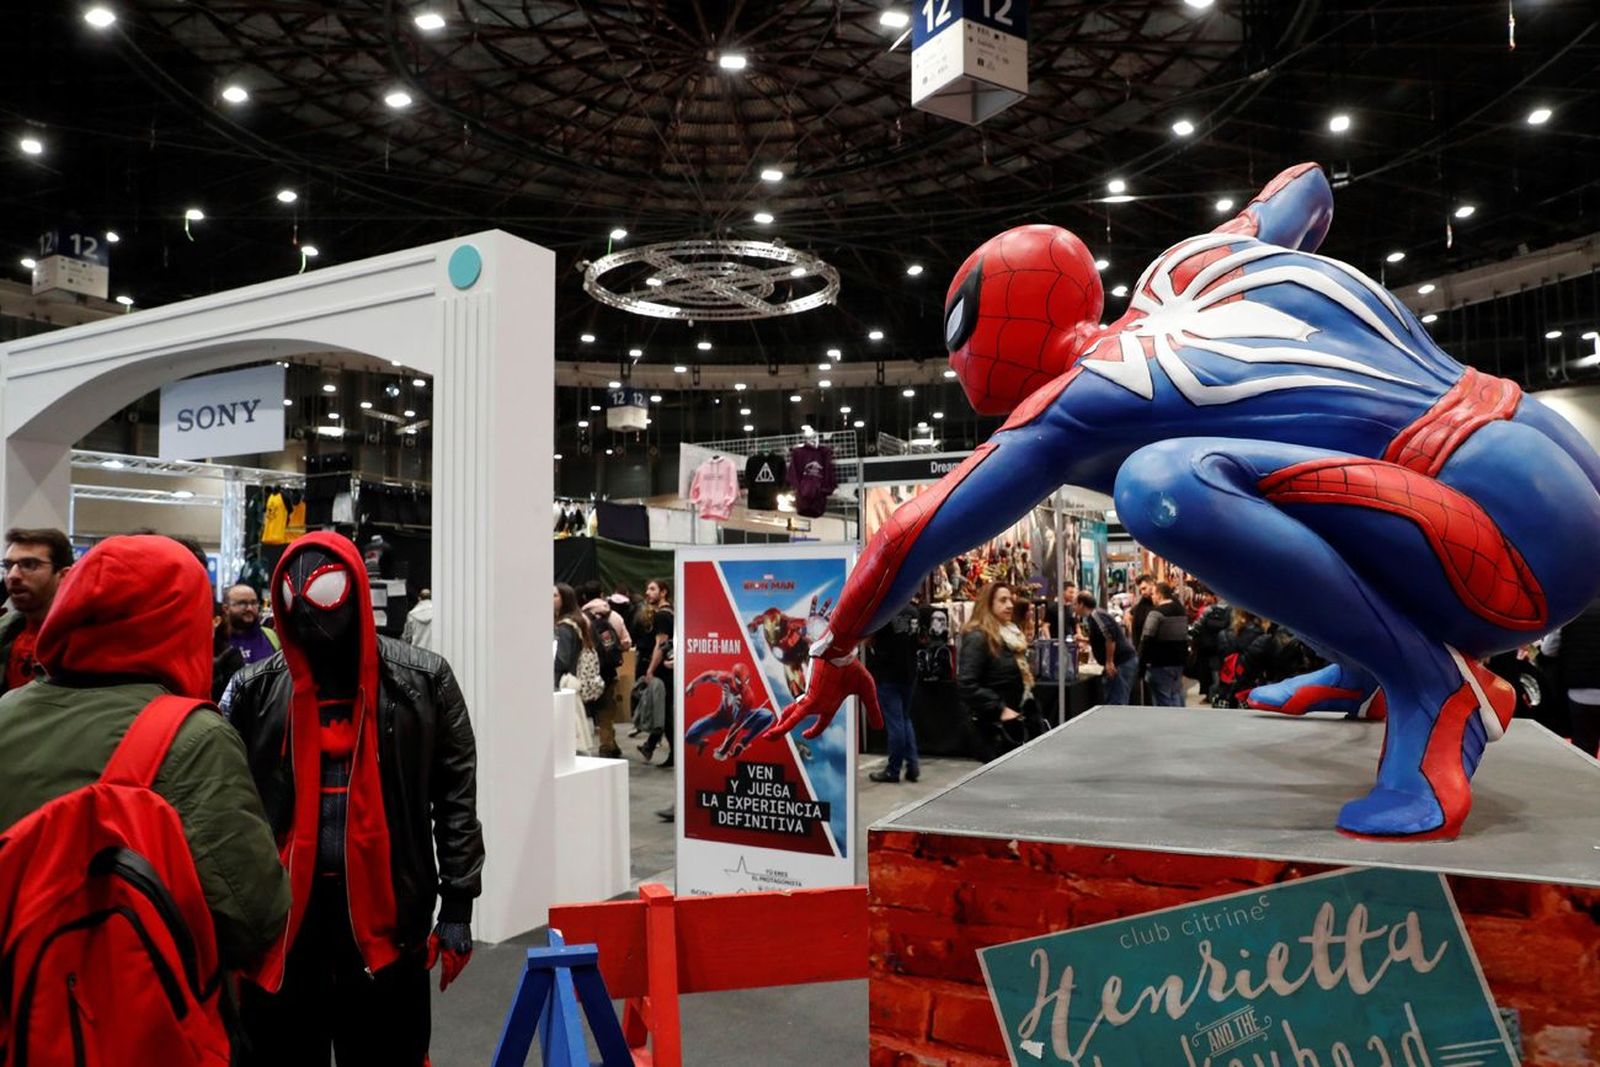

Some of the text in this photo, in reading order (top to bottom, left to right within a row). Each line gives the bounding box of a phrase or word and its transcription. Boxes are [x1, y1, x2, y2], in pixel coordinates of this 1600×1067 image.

[922, 0, 951, 33] 12
[70, 233, 98, 259] 12
[612, 391, 625, 405] 12
[633, 392, 644, 406] 12
[177, 399, 261, 432] SONY
[771, 580, 794, 591] MAN
[687, 638, 741, 654] SPIDER-MAN
[747, 765, 773, 780] VEN
[731, 780, 790, 798] Y JUEGA
[702, 793, 822, 818] LA EXPERIENCIA
[718, 811, 804, 833] DEFINITIVA
[1119, 923, 1170, 949] club
[1018, 902, 1448, 1063] Henrietta
[1207, 1009, 1260, 1052] AND THE
